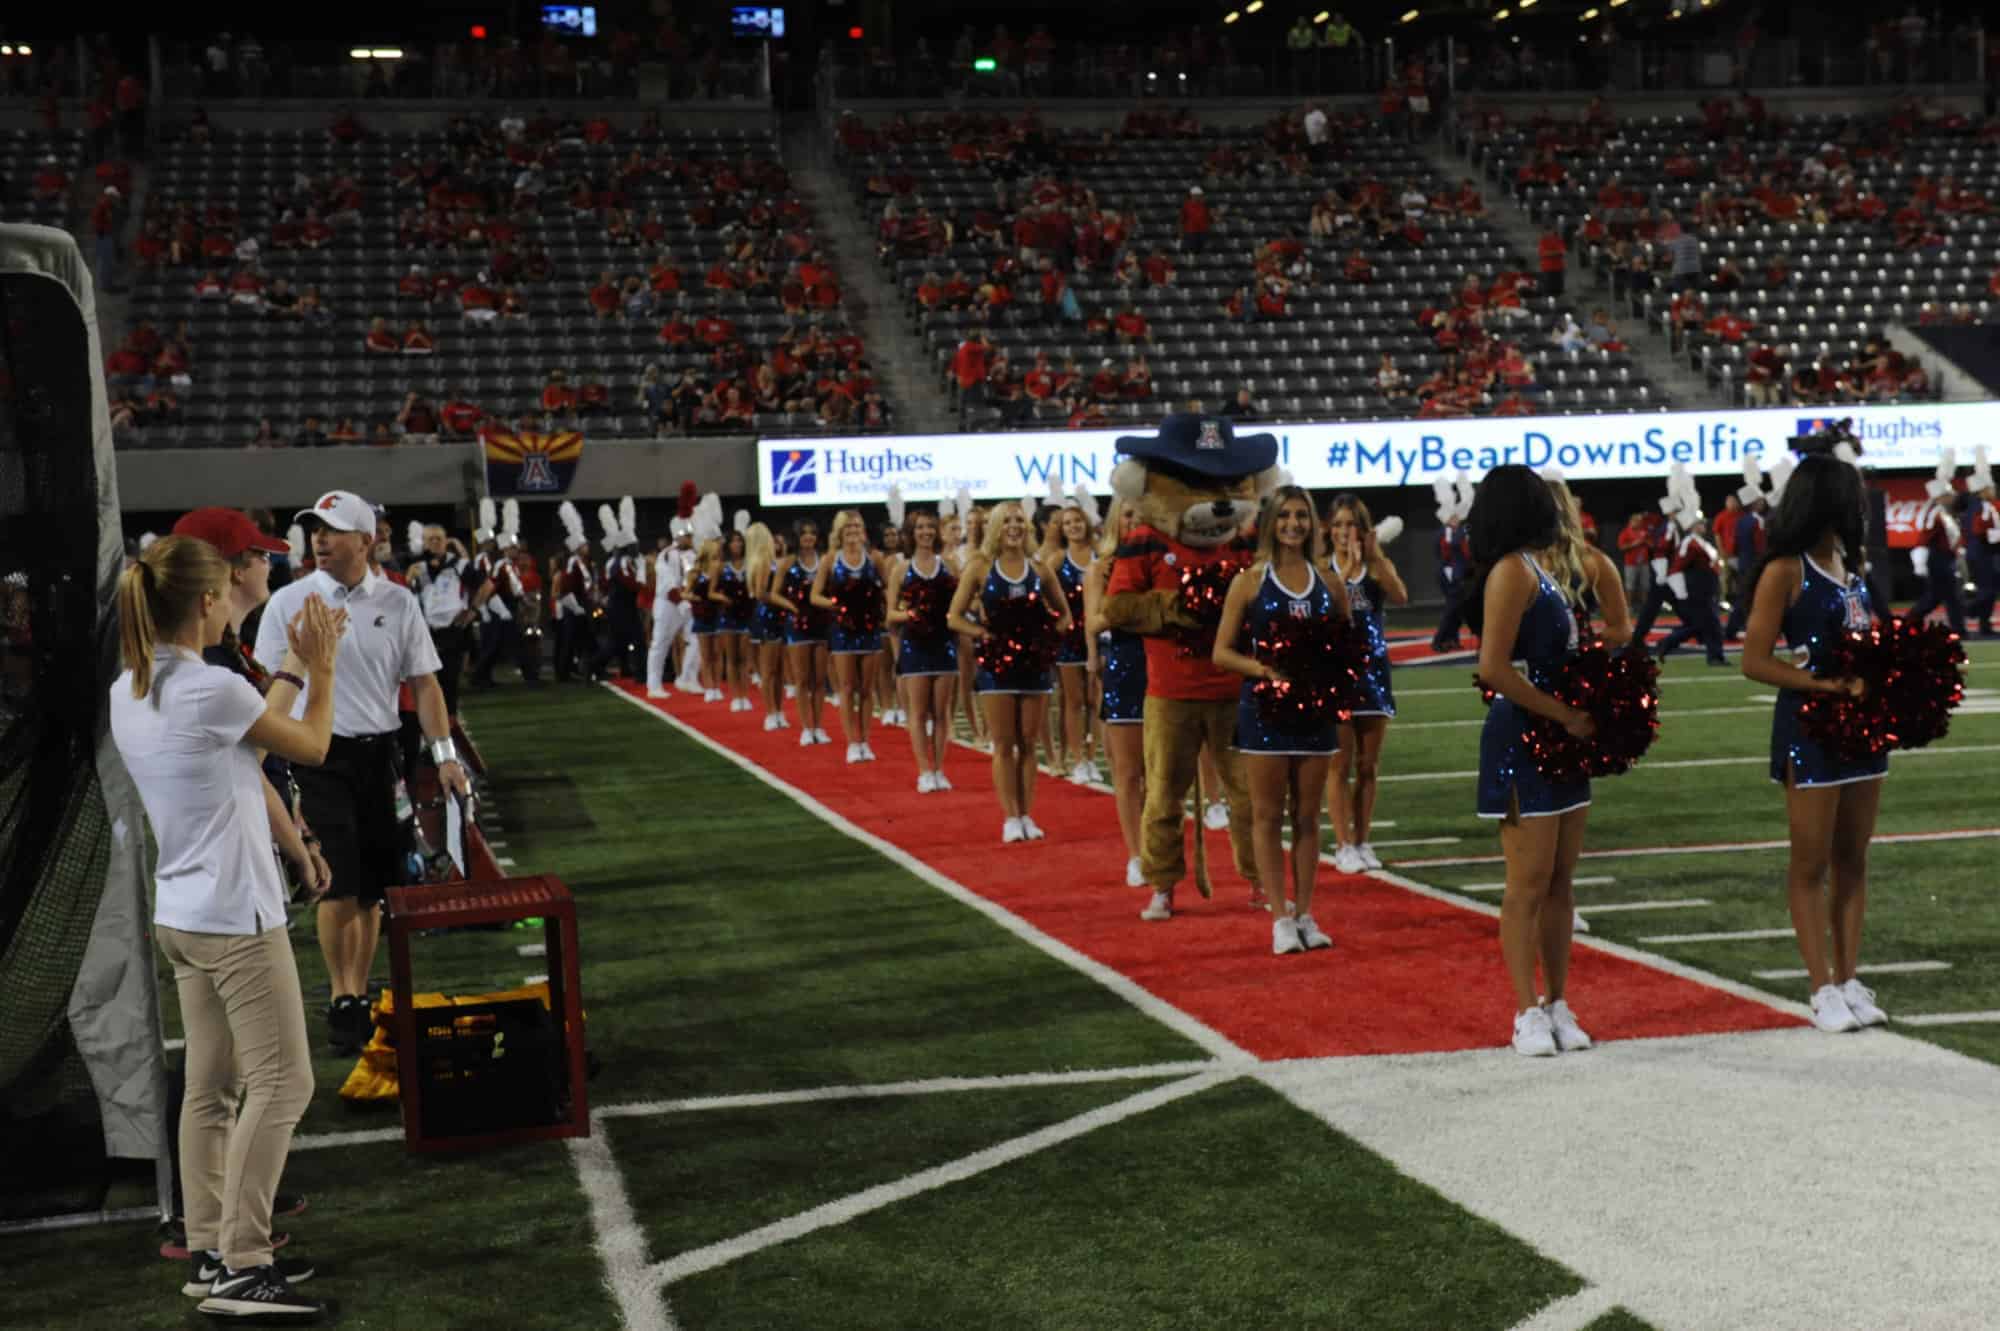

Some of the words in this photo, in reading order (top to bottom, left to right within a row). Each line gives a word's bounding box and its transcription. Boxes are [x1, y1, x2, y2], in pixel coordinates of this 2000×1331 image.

[824, 448, 932, 479] Hughes
[1015, 452, 1096, 483] WIN
[1326, 424, 1765, 486] #MyBearDownSelfie
